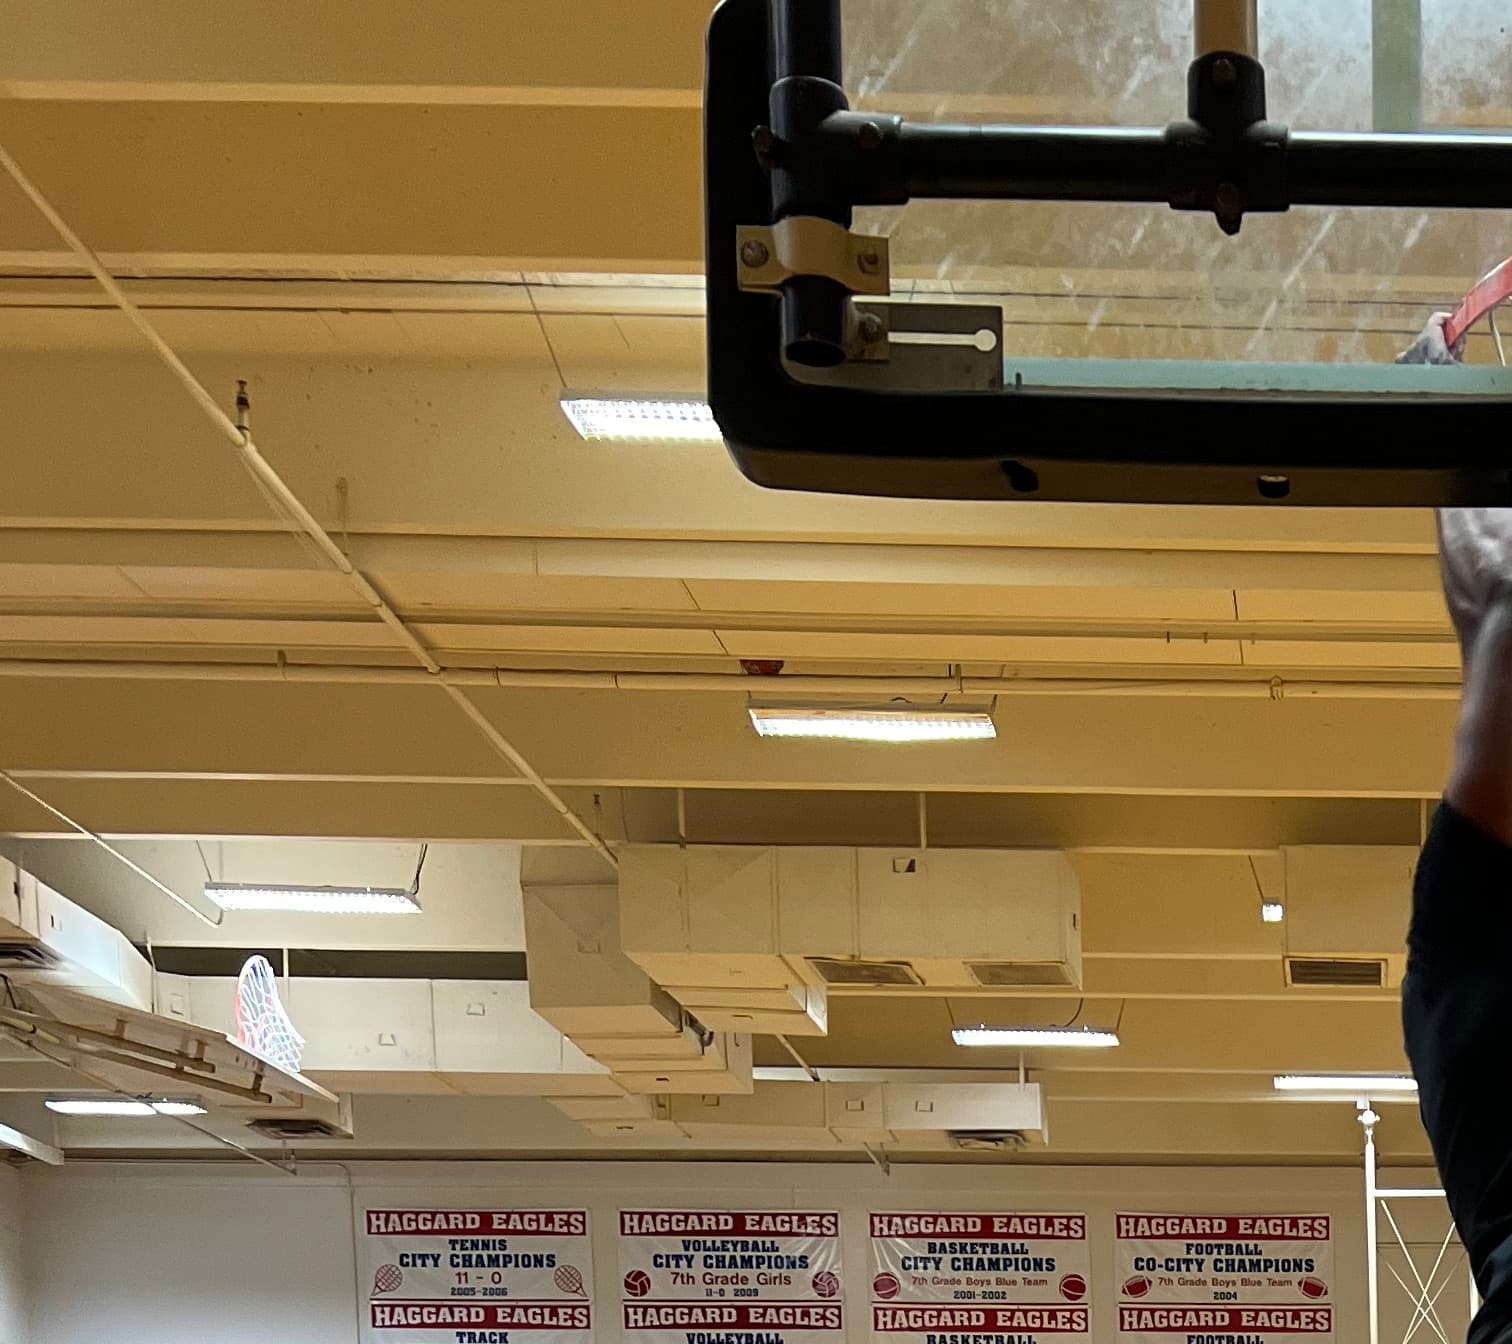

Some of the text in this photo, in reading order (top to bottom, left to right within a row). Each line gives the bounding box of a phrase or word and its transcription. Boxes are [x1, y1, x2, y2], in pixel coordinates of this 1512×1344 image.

[369, 1212, 584, 1234] HAGGARD EAGLES
[623, 1214, 836, 1234] HAGGARD EAGLES
[872, 1217, 1083, 1237] HAGGARD EAGLES
[1120, 1218, 1328, 1239] HAGGARD EAGLES
[448, 1240, 507, 1251] TENNIS
[681, 1240, 779, 1252] VOLLEYBALL
[928, 1242, 1029, 1254] BASKETBALL
[1186, 1244, 1262, 1255] FOOTBALL
[400, 1254, 556, 1268] CITY CHAMPIONS
[653, 1255, 809, 1269] CITY CHAMPIONS
[901, 1257, 1056, 1271] CITY CHAMPIONS
[1134, 1258, 1314, 1272] CO-CITY CHAMPIONS
[455, 1272, 469, 1284] 11
[671, 1272, 792, 1285] 7th Grade Girls
[912, 1276, 1048, 1286] 7th Grade Boys Blue Team
[1158, 1278, 1292, 1287] 7th Grade Boys Blue Team
[1213, 1292, 1237, 1300] 2004
[375, 1307, 588, 1327] HAGGARD EAGLES
[628, 1308, 839, 1327] HAGGARD EAGLES
[876, 1310, 1086, 1331] HAGGARD EAGLES
[1123, 1310, 1330, 1330] HAGGARD EAGLES
[456, 1332, 509, 1343] TRACK
[686, 1334, 783, 1344] VOLLEYBALL
